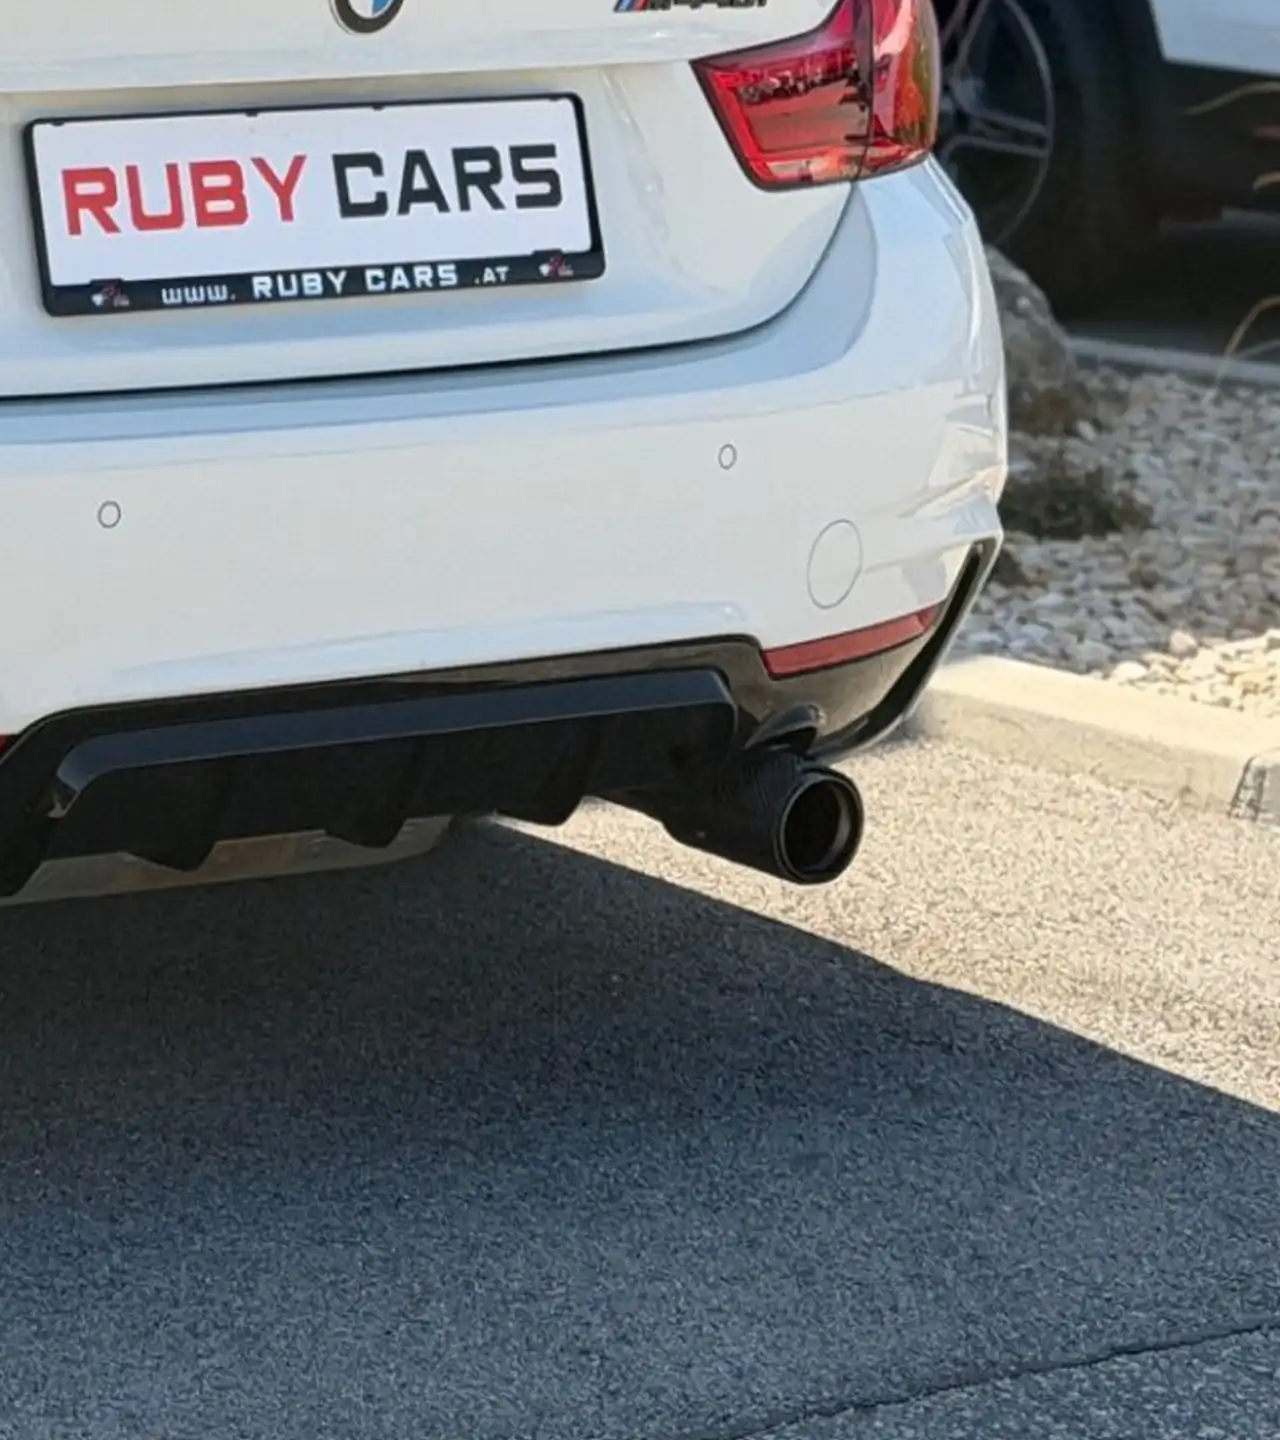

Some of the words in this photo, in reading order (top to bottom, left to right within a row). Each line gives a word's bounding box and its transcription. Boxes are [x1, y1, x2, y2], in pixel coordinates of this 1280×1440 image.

[62, 156, 305, 236] RUBY
[331, 142, 563, 220] CARS
[251, 270, 347, 300] RUBY
[363, 263, 459, 291] CARS
[473, 265, 510, 284] .AT
